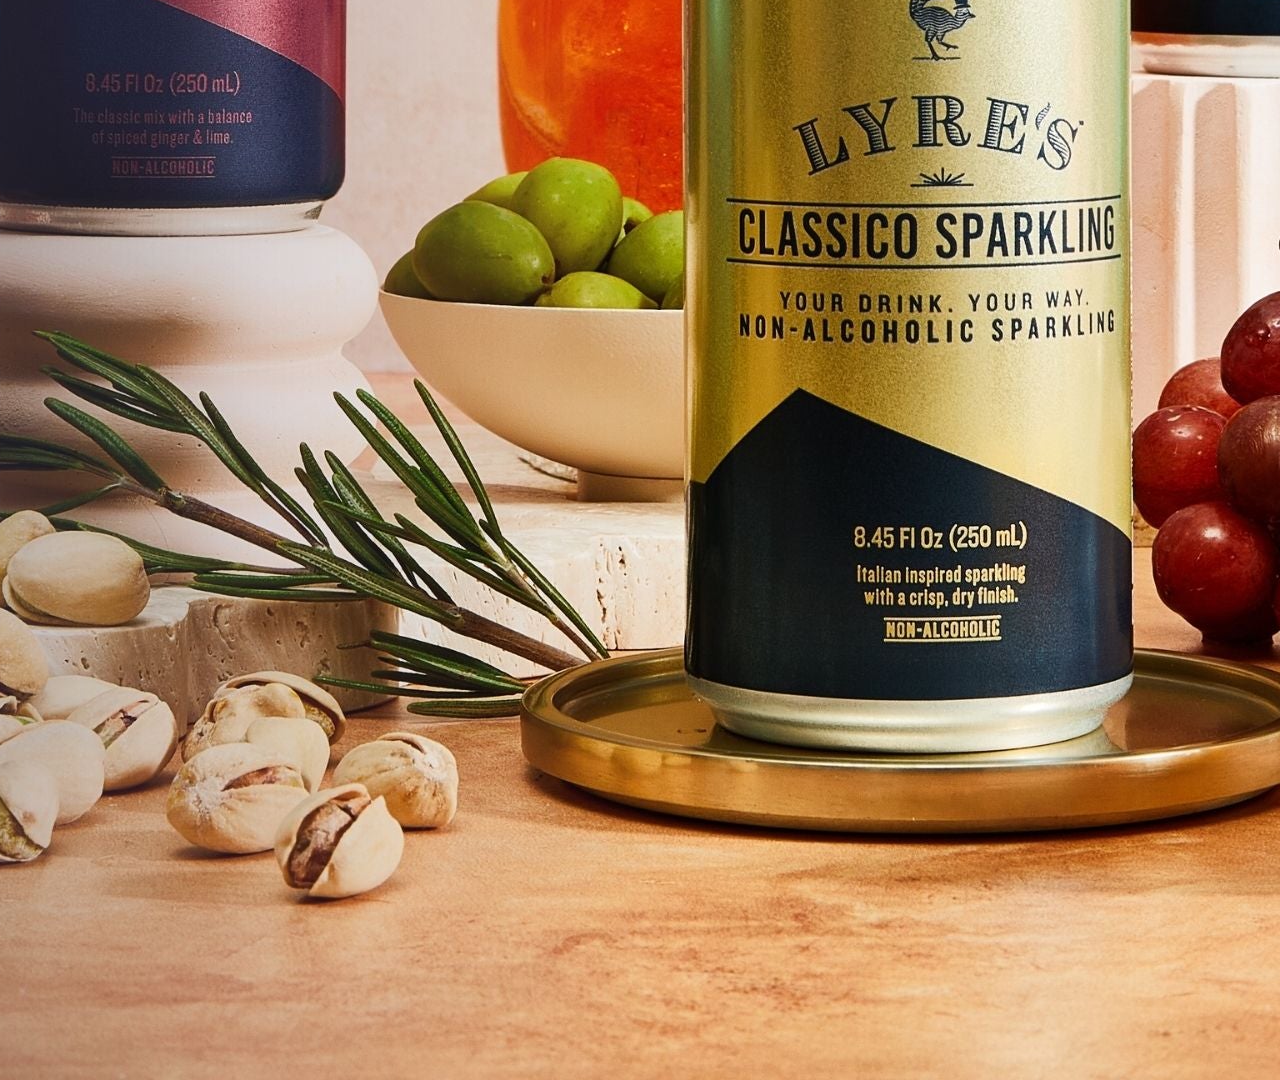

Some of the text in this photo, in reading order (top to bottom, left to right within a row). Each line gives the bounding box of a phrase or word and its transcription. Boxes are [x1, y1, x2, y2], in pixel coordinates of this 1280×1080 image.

[85, 73, 120, 93] 8.45
[144, 74, 163, 93] Oz
[170, 72, 206, 96] (250
[212, 71, 240, 96] mL)
[73, 108, 252, 124] The classic mix with a balance
[92, 130, 233, 148] of spiced ginger & lime.
[792, 95, 1079, 176] LYRE'S
[112, 160, 214, 175] NON-ALCOHOLIC
[739, 205, 1115, 259] CLASSICO SPARKLING
[780, 288, 1089, 313] YOUR DRINK. YOUR WAY.
[739, 309, 1115, 343] NON-ALCOHOLIC SPARKLING
[854, 526, 894, 548] 8.45
[920, 527, 943, 549] Oz
[948, 524, 992, 553] (250
[995, 520, 1028, 550] mL)
[857, 563, 1025, 588] Italian inspired sparkling
[864, 586, 1019, 610] with a crisp, dry finish.
[885, 619, 1000, 638] NON-ALCOHOLIC
